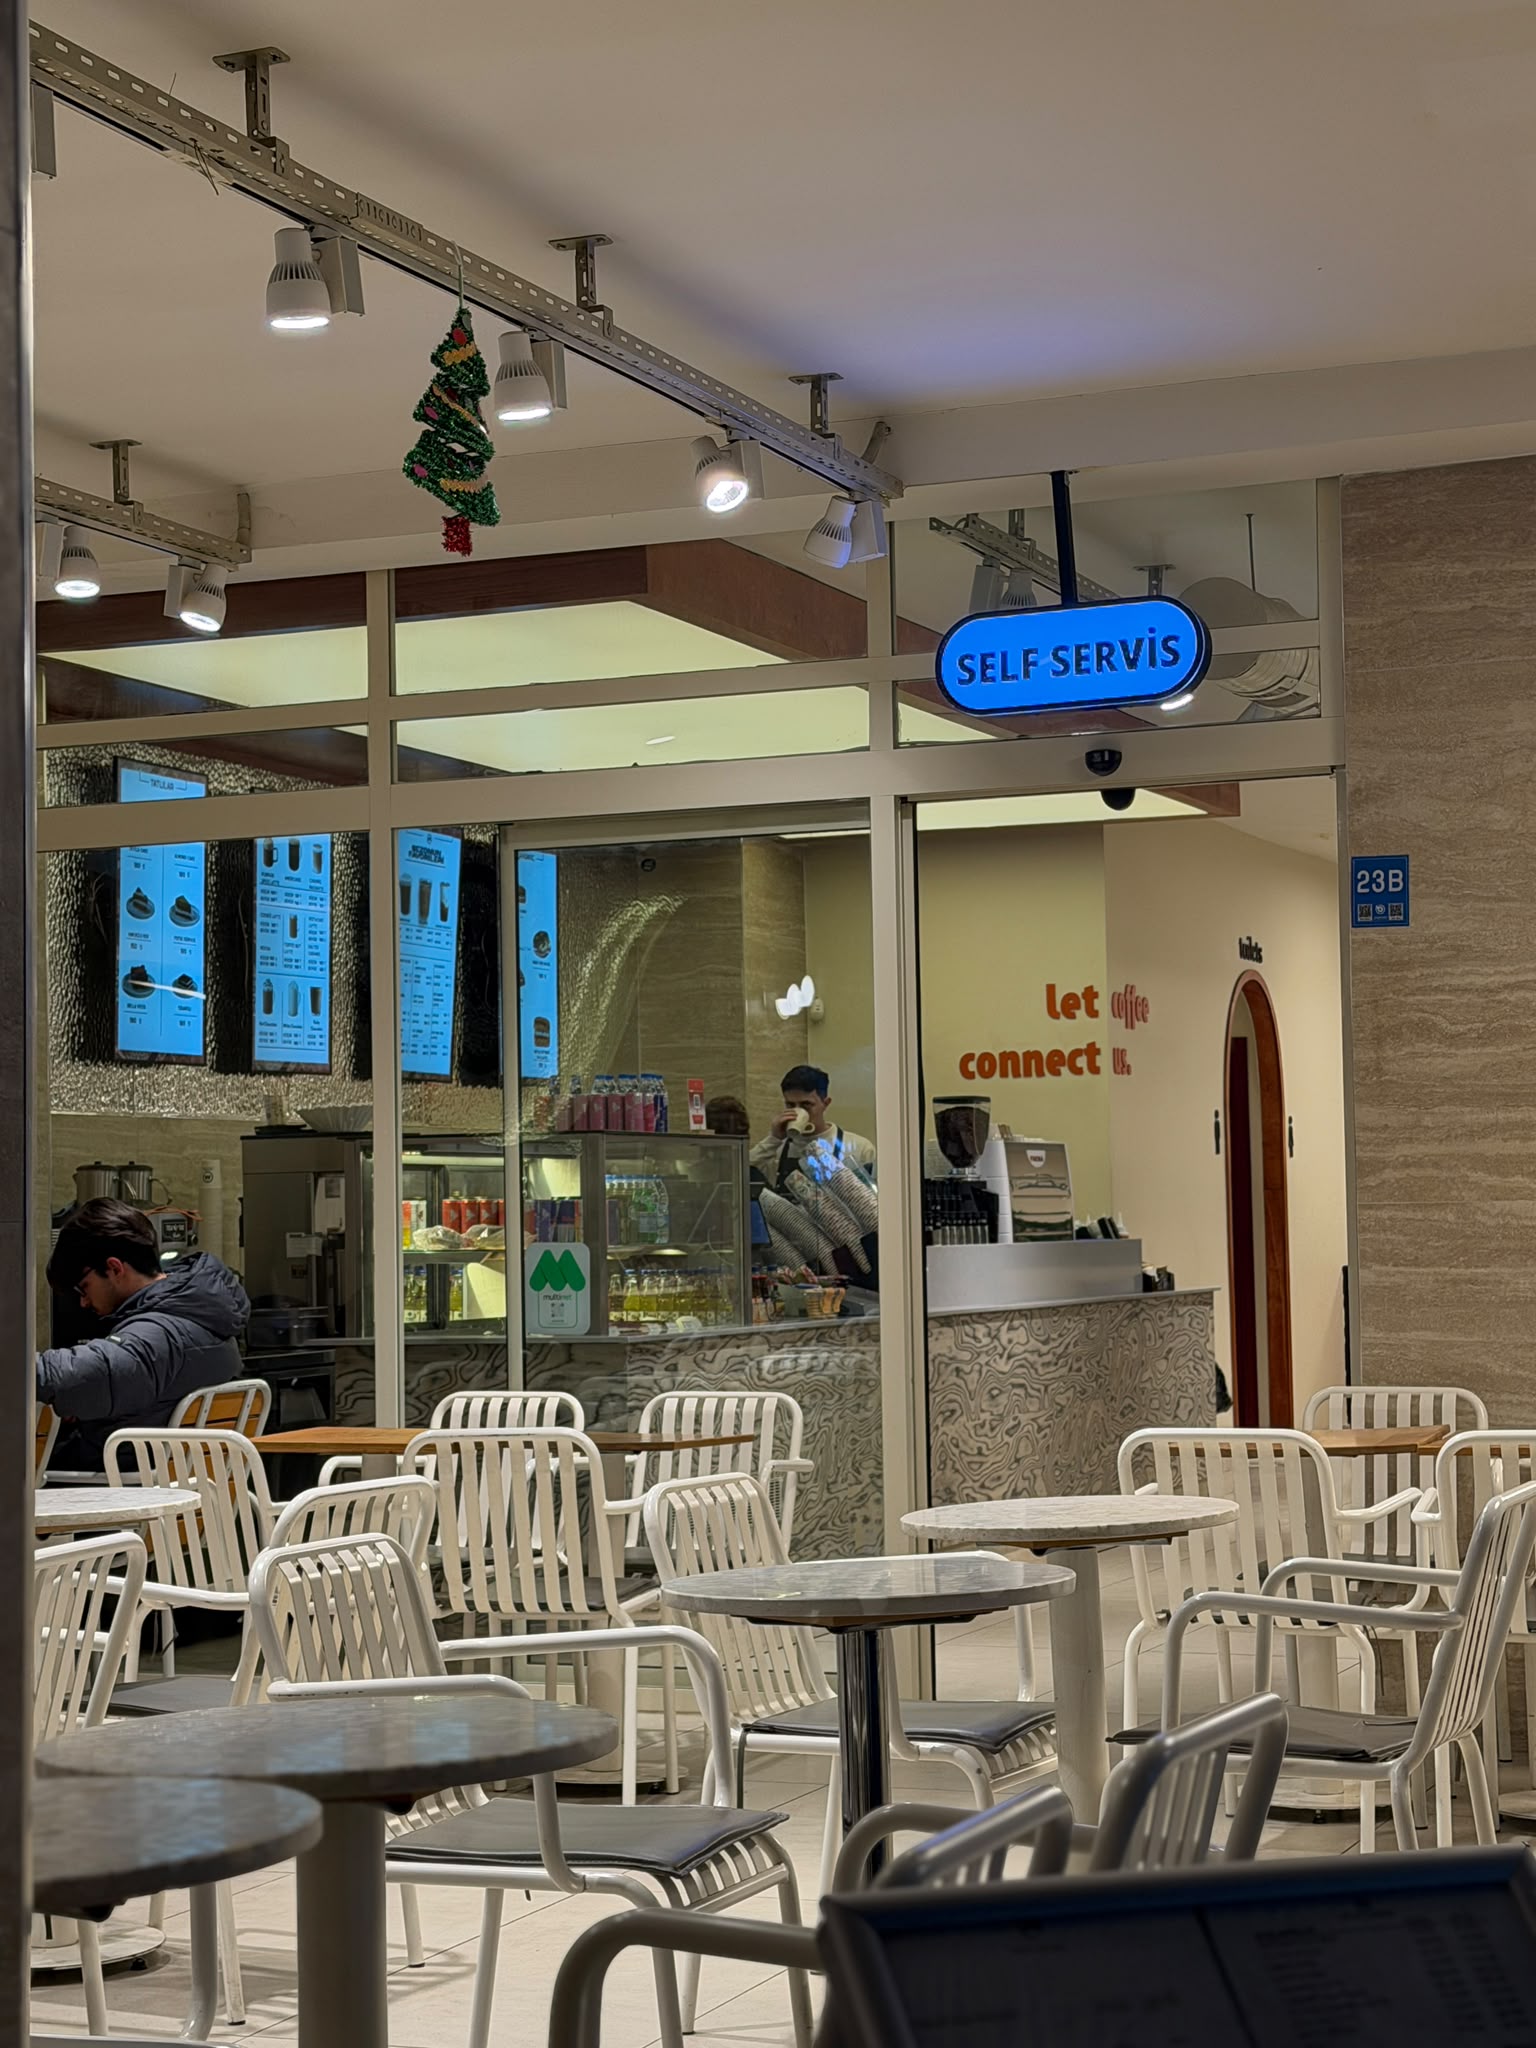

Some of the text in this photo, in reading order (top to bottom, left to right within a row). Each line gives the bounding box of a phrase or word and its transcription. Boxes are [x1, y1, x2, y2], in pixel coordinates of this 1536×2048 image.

[956, 626, 1182, 686] SELF SERVİS
[1357, 869, 1404, 893] 23B
[1045, 983, 1150, 1030] let coffee
[959, 1041, 1132, 1081] connect us.
[542, 1293, 573, 1302] multinet
